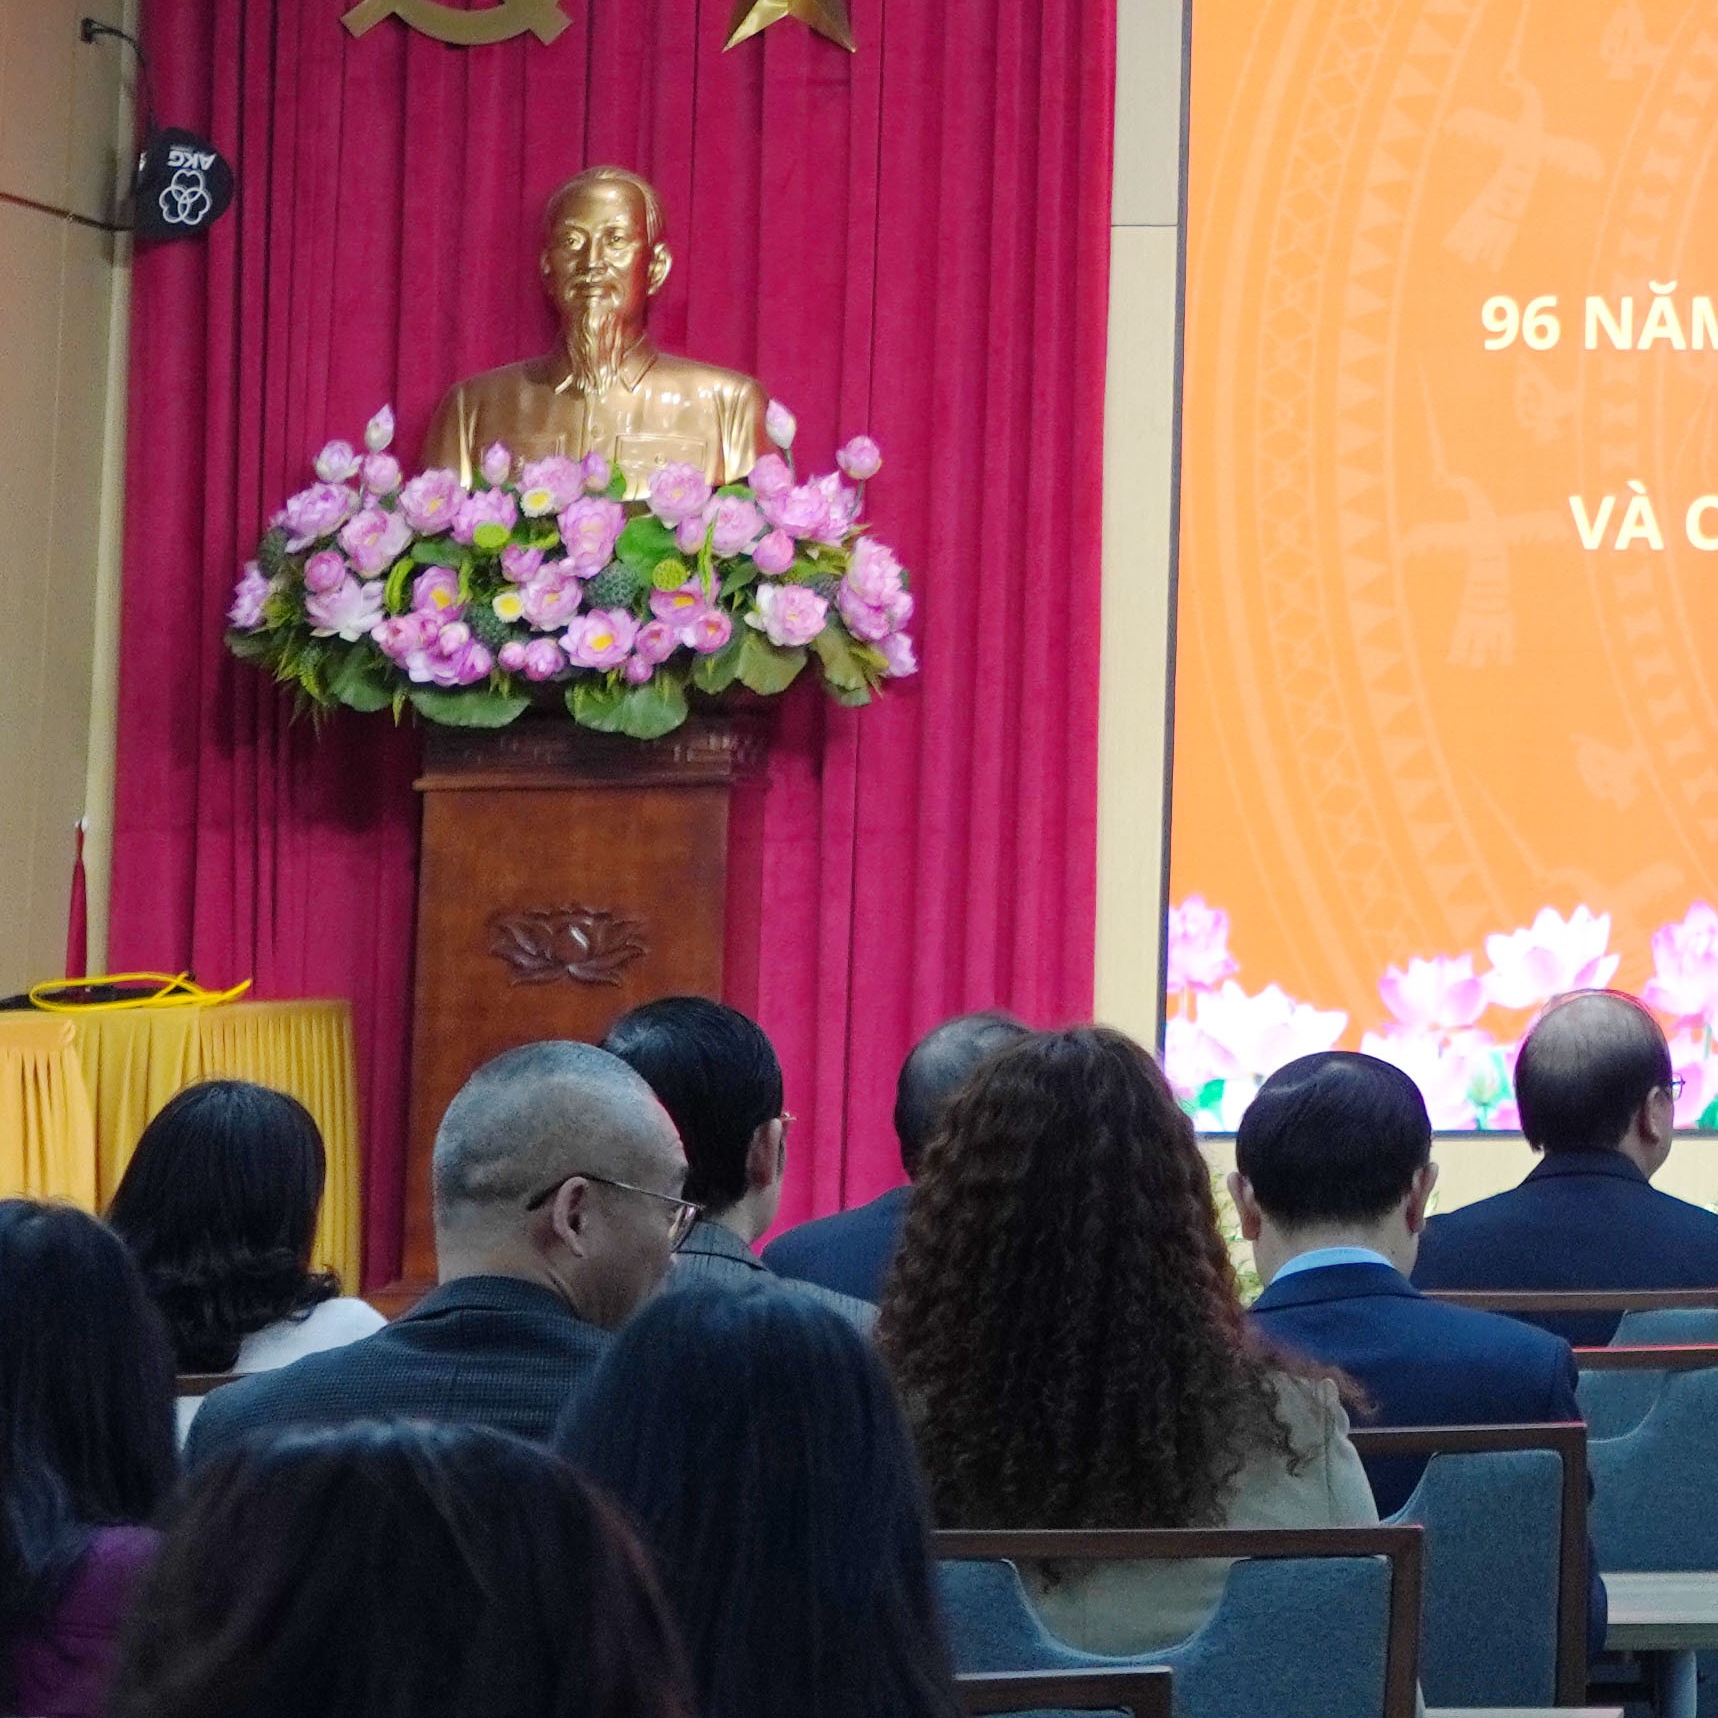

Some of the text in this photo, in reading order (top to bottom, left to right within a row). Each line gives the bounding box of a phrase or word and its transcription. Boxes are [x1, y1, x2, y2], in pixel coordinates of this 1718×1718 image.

[169, 151, 215, 170] AKG
[1482, 296, 1559, 350] 96
[1569, 480, 1664, 550] VÀ
